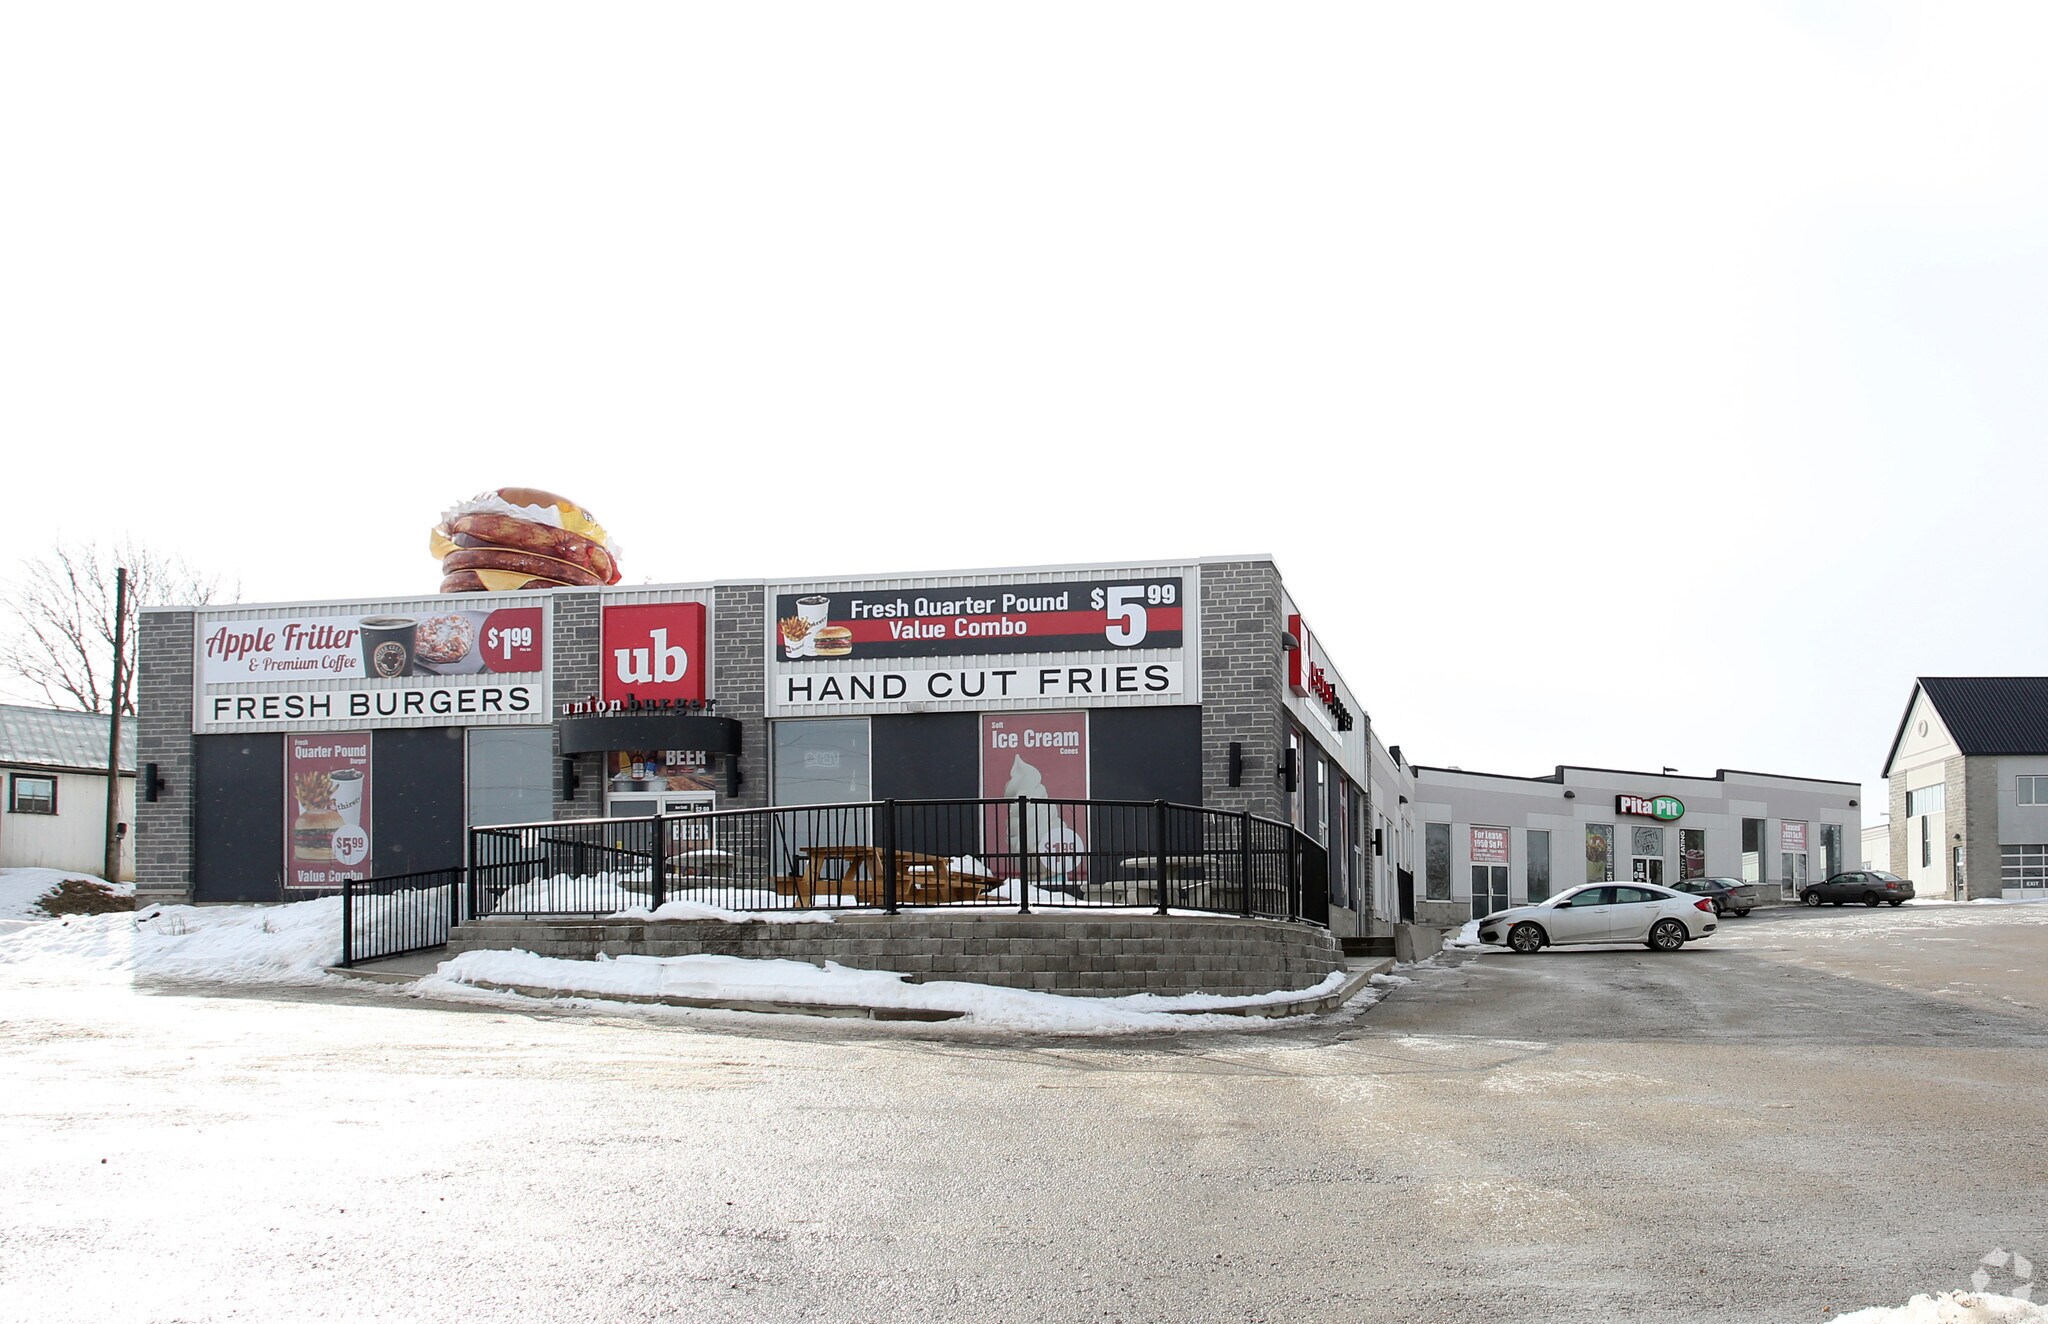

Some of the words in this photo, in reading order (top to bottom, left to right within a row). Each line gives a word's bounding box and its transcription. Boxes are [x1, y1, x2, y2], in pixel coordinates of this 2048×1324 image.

[850, 599, 909, 619] Fresh
[914, 596, 997, 617] Quarter
[1001, 591, 1069, 613] Pound
[888, 620, 946, 640] Value
[953, 617, 1028, 637] Combo
[205, 626, 276, 662] Apple
[282, 623, 359, 651] Fritter
[249, 658, 259, 672] &
[263, 657, 318, 672] Premium
[321, 654, 357, 673] Coffee
[614, 627, 688, 684] ub
[788, 674, 908, 702] HAND
[927, 669, 1018, 698] CUT
[1039, 664, 1170, 695] FRIES
[213, 694, 331, 720] FRESH
[350, 687, 530, 716] BURGERS
[562, 695, 623, 715] union
[626, 693, 716, 716] burger
[992, 730, 1018, 749] Ice
[1023, 729, 1080, 748] Cream
[295, 746, 333, 759] Quarter
[334, 744, 367, 757] Pound
[665, 750, 707, 766] BEER
[1620, 796, 1653, 814] Pita
[1656, 799, 1678, 816] Pit
[1474, 830, 1485, 839] For
[1485, 830, 1503, 840] Lease
[1605, 826, 1613, 869] THINKING
[297, 870, 326, 883] Value
